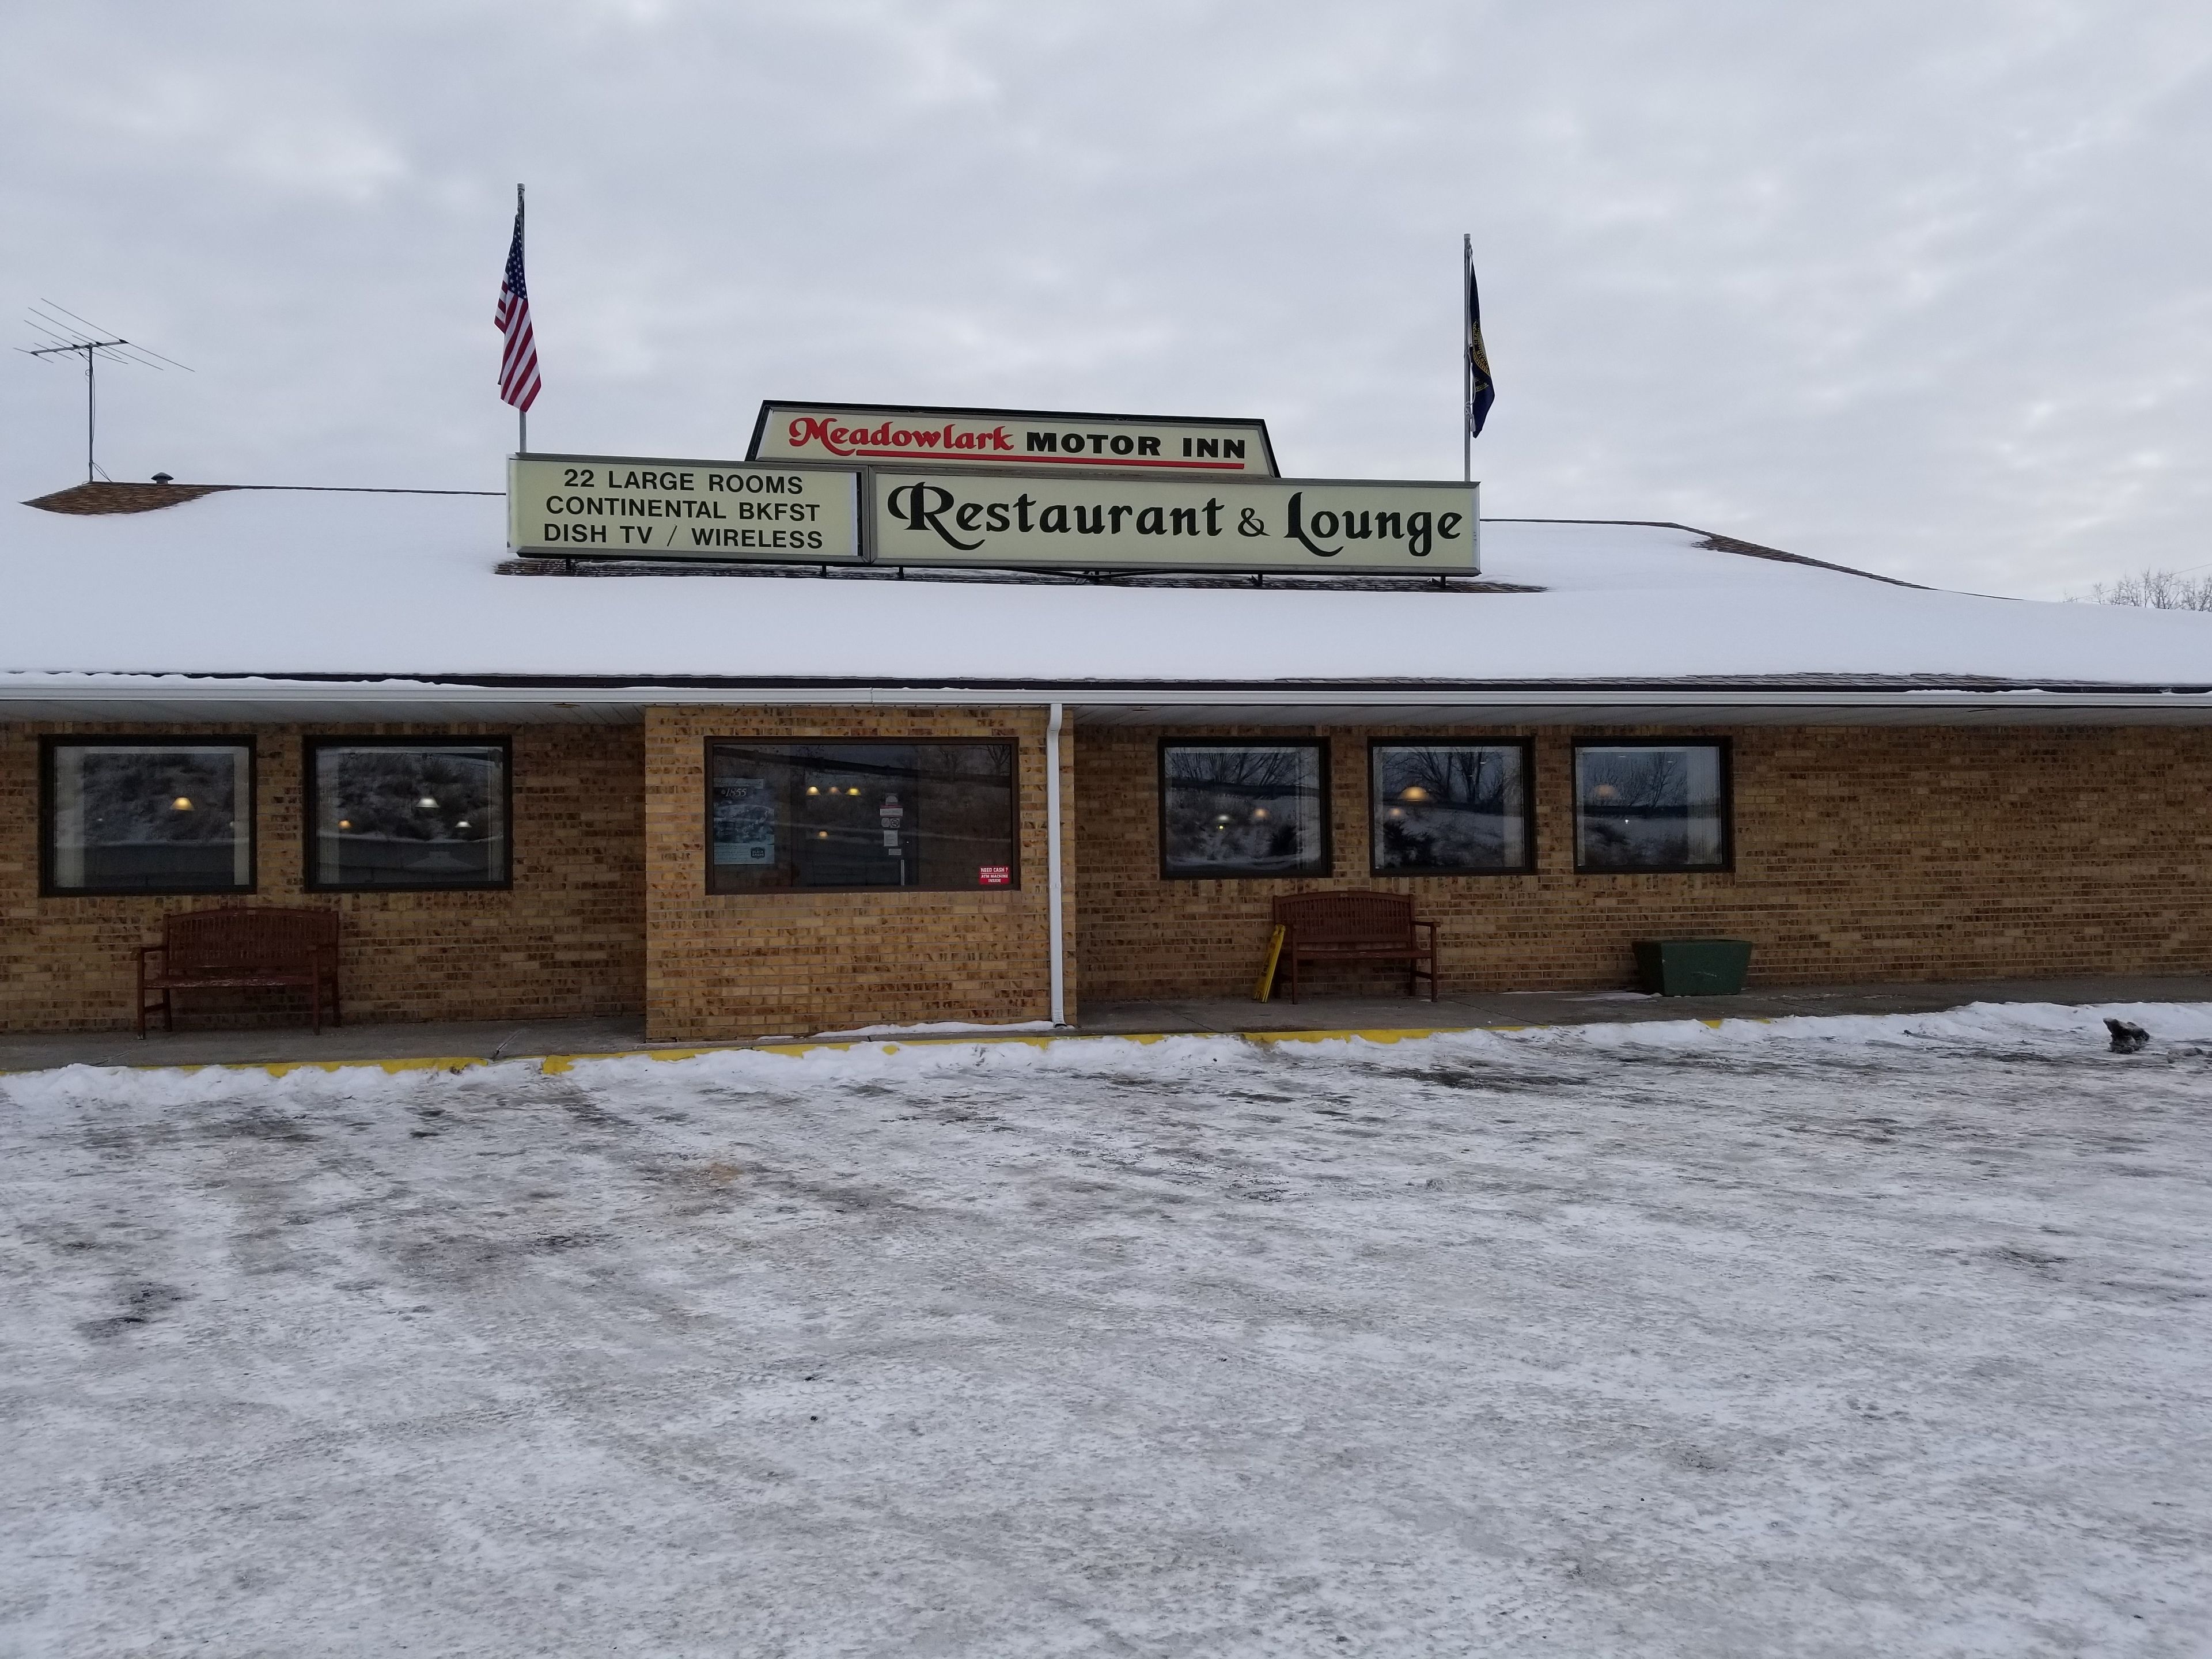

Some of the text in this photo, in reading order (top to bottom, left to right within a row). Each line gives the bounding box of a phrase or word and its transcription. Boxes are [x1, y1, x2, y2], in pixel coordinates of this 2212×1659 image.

[789, 418, 1245, 459] Meadowlark MOTOR INN
[564, 468, 803, 495] 22 LARGE ROOMS
[546, 495, 820, 522] CONTINENTAL BKFST
[887, 482, 1463, 558] Restaurant & Lounge
[544, 523, 823, 549] DISH TV / WIRELESS
[725, 787, 747, 797] 1855
